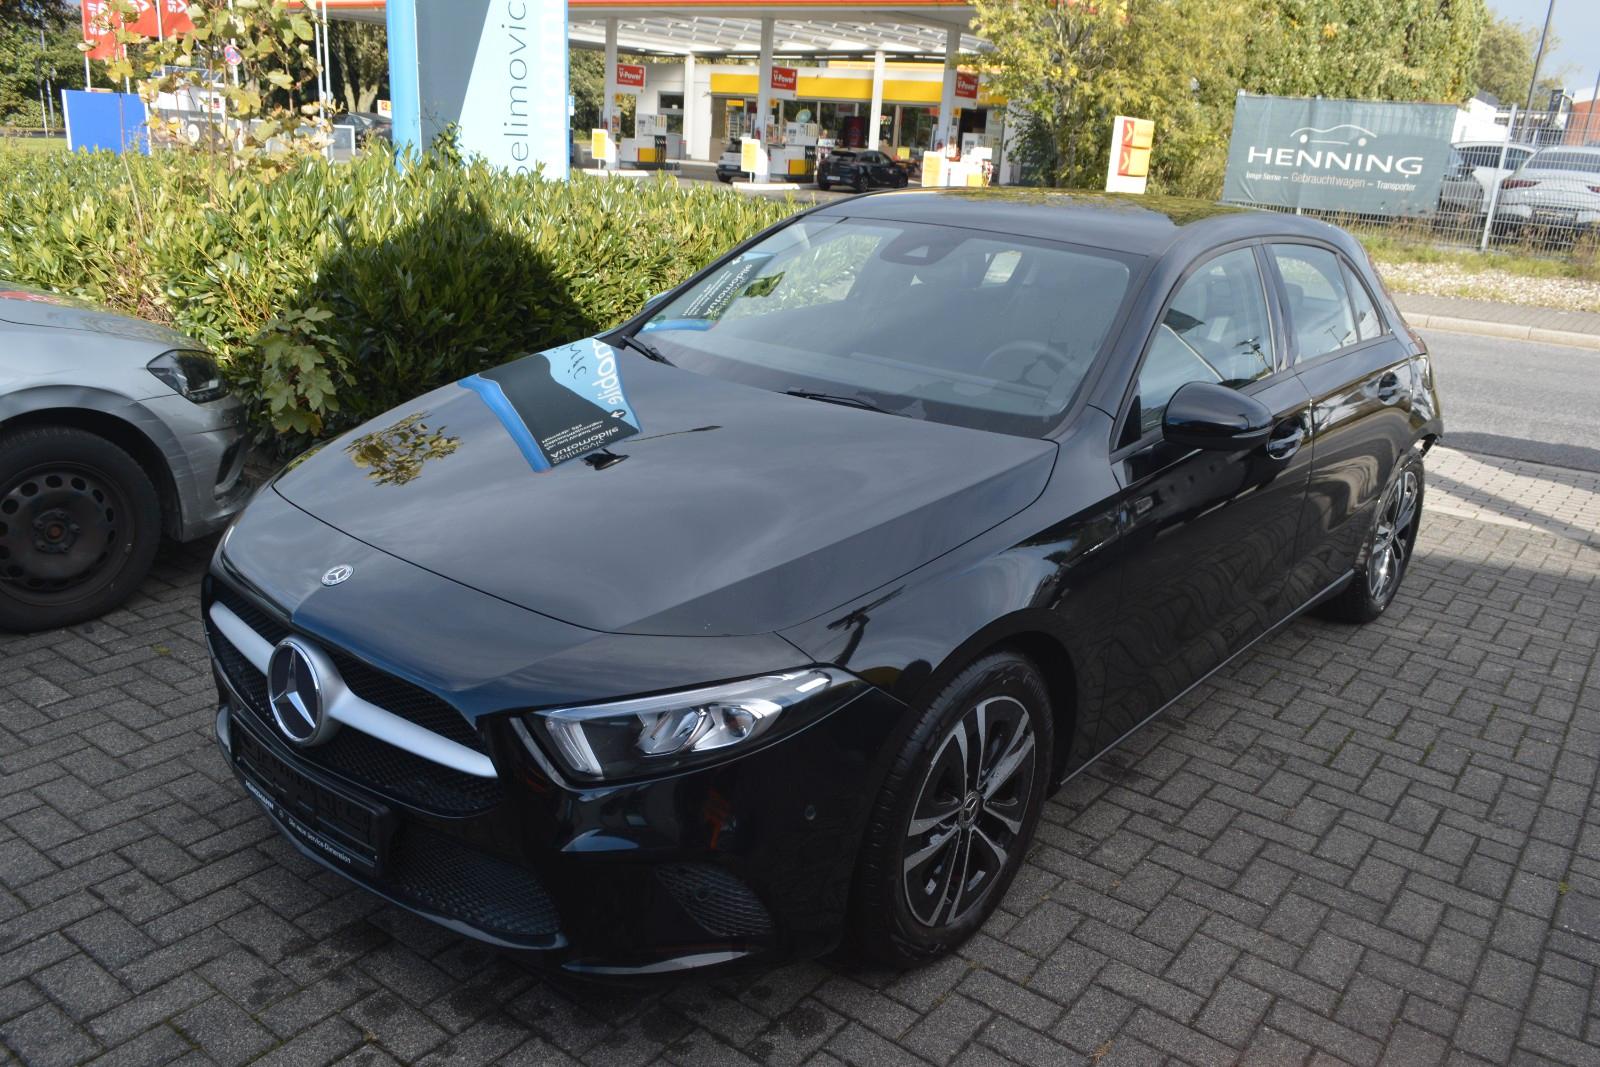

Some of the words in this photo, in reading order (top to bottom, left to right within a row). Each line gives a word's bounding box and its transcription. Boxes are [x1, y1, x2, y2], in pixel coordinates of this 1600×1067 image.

[619, 71, 641, 80] V-Power
[773, 73, 794, 84] V-Power
[1247, 146, 1424, 175] HENNING
[1291, 172, 1365, 189] Gebrauchtwagen
[1377, 180, 1416, 192] Transporter
